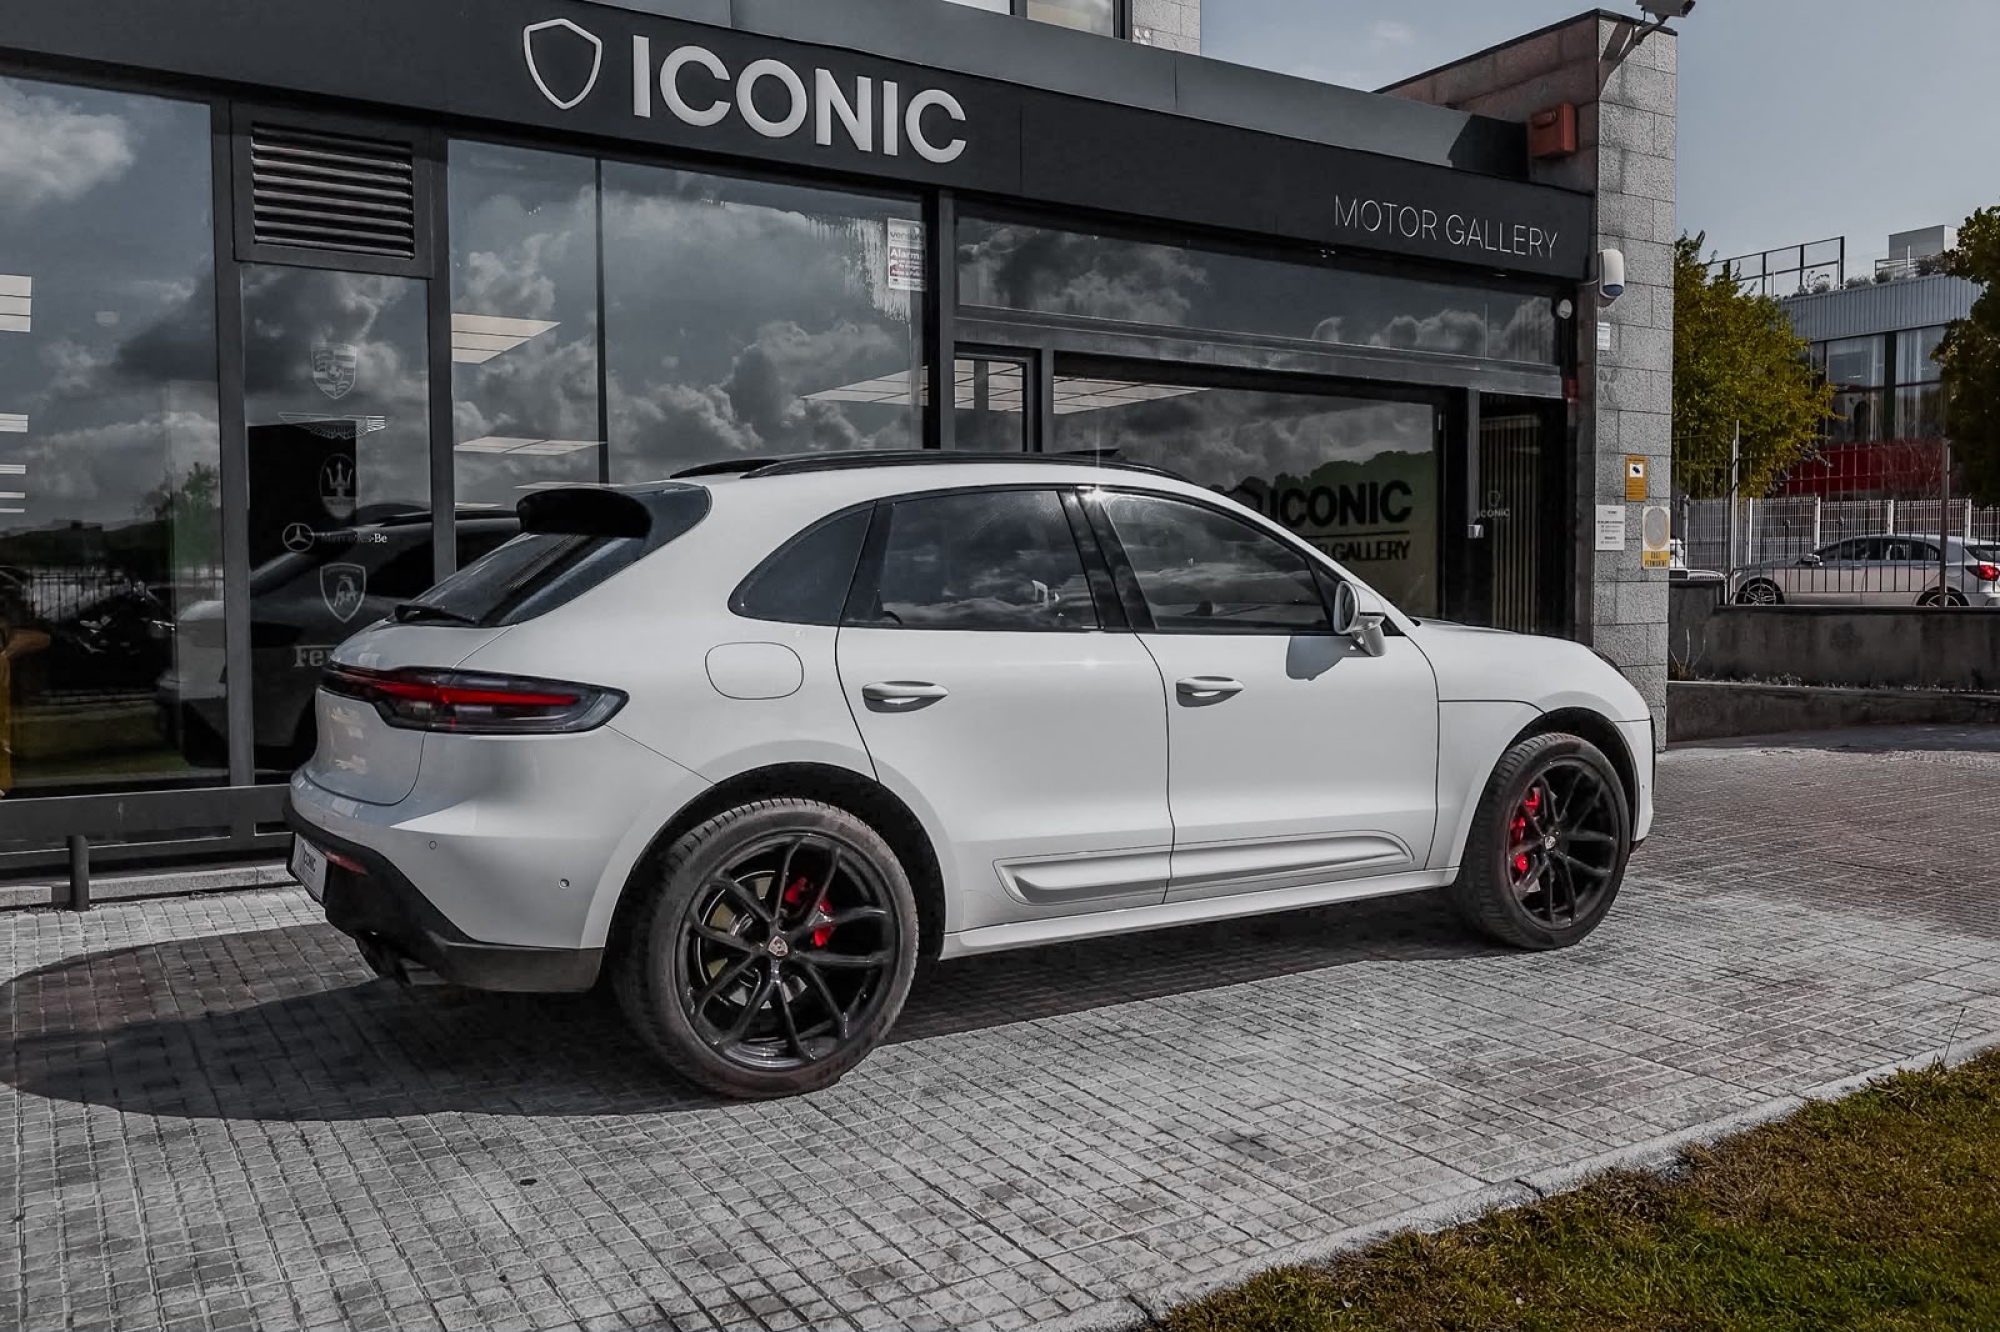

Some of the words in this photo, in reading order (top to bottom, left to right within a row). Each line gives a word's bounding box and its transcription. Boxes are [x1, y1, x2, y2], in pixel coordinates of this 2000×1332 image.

[633, 34, 967, 163] ICONIC
[1335, 195, 1437, 241] MOTOR
[1445, 214, 1558, 259] GALLERY
[1269, 480, 1412, 528] ICONIC
[1332, 540, 1411, 561] GALLERY
